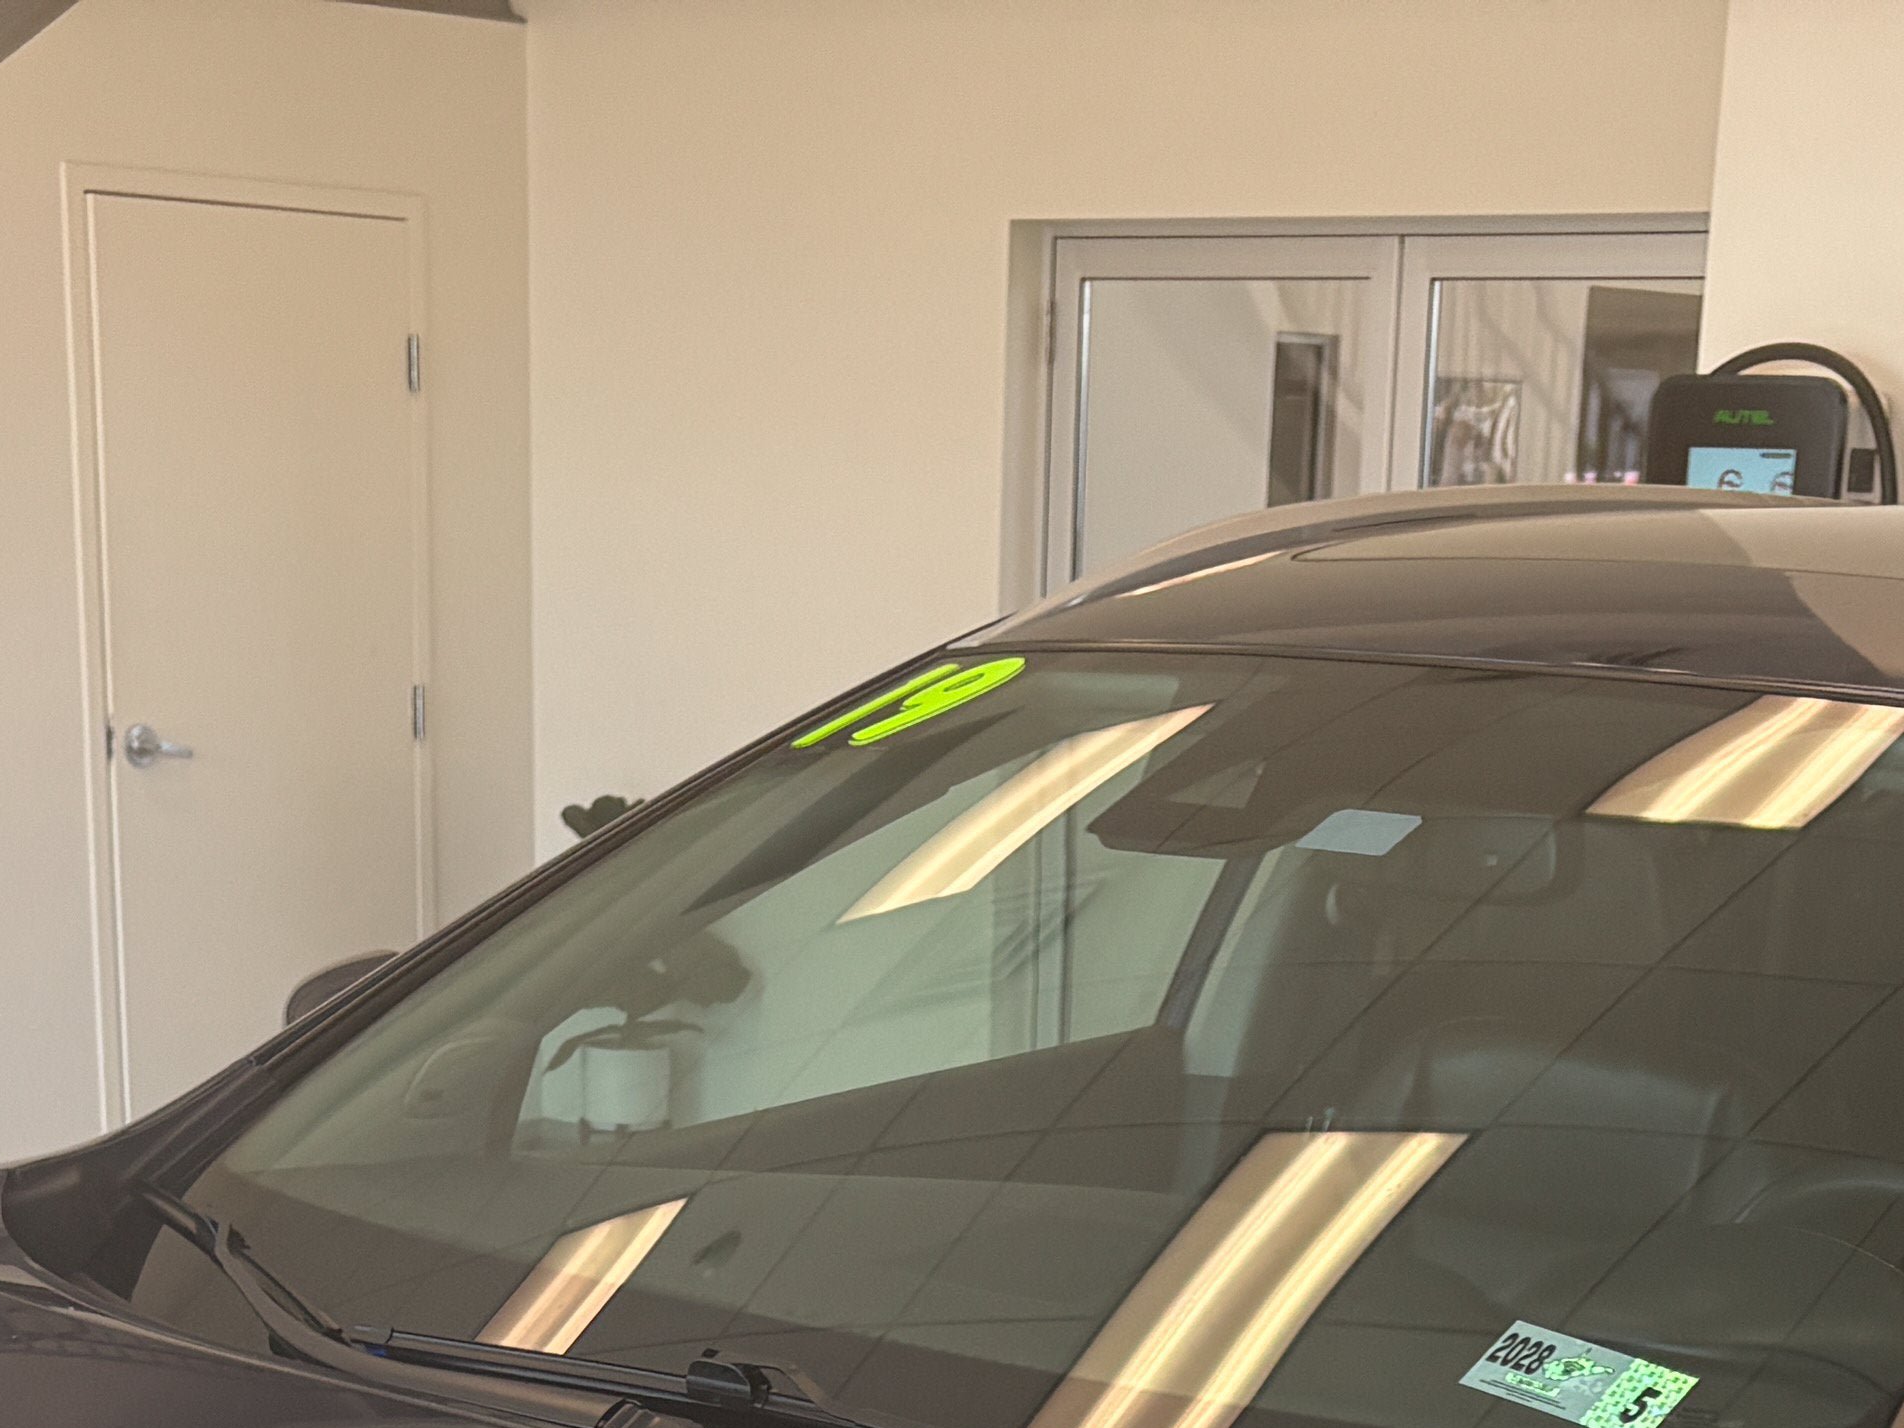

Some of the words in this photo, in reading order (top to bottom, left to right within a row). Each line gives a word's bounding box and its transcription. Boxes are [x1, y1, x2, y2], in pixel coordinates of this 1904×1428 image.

[791, 656, 1026, 749] 19
[1485, 1331, 1558, 1376] 2028
[1619, 1386, 1663, 1425] 5
